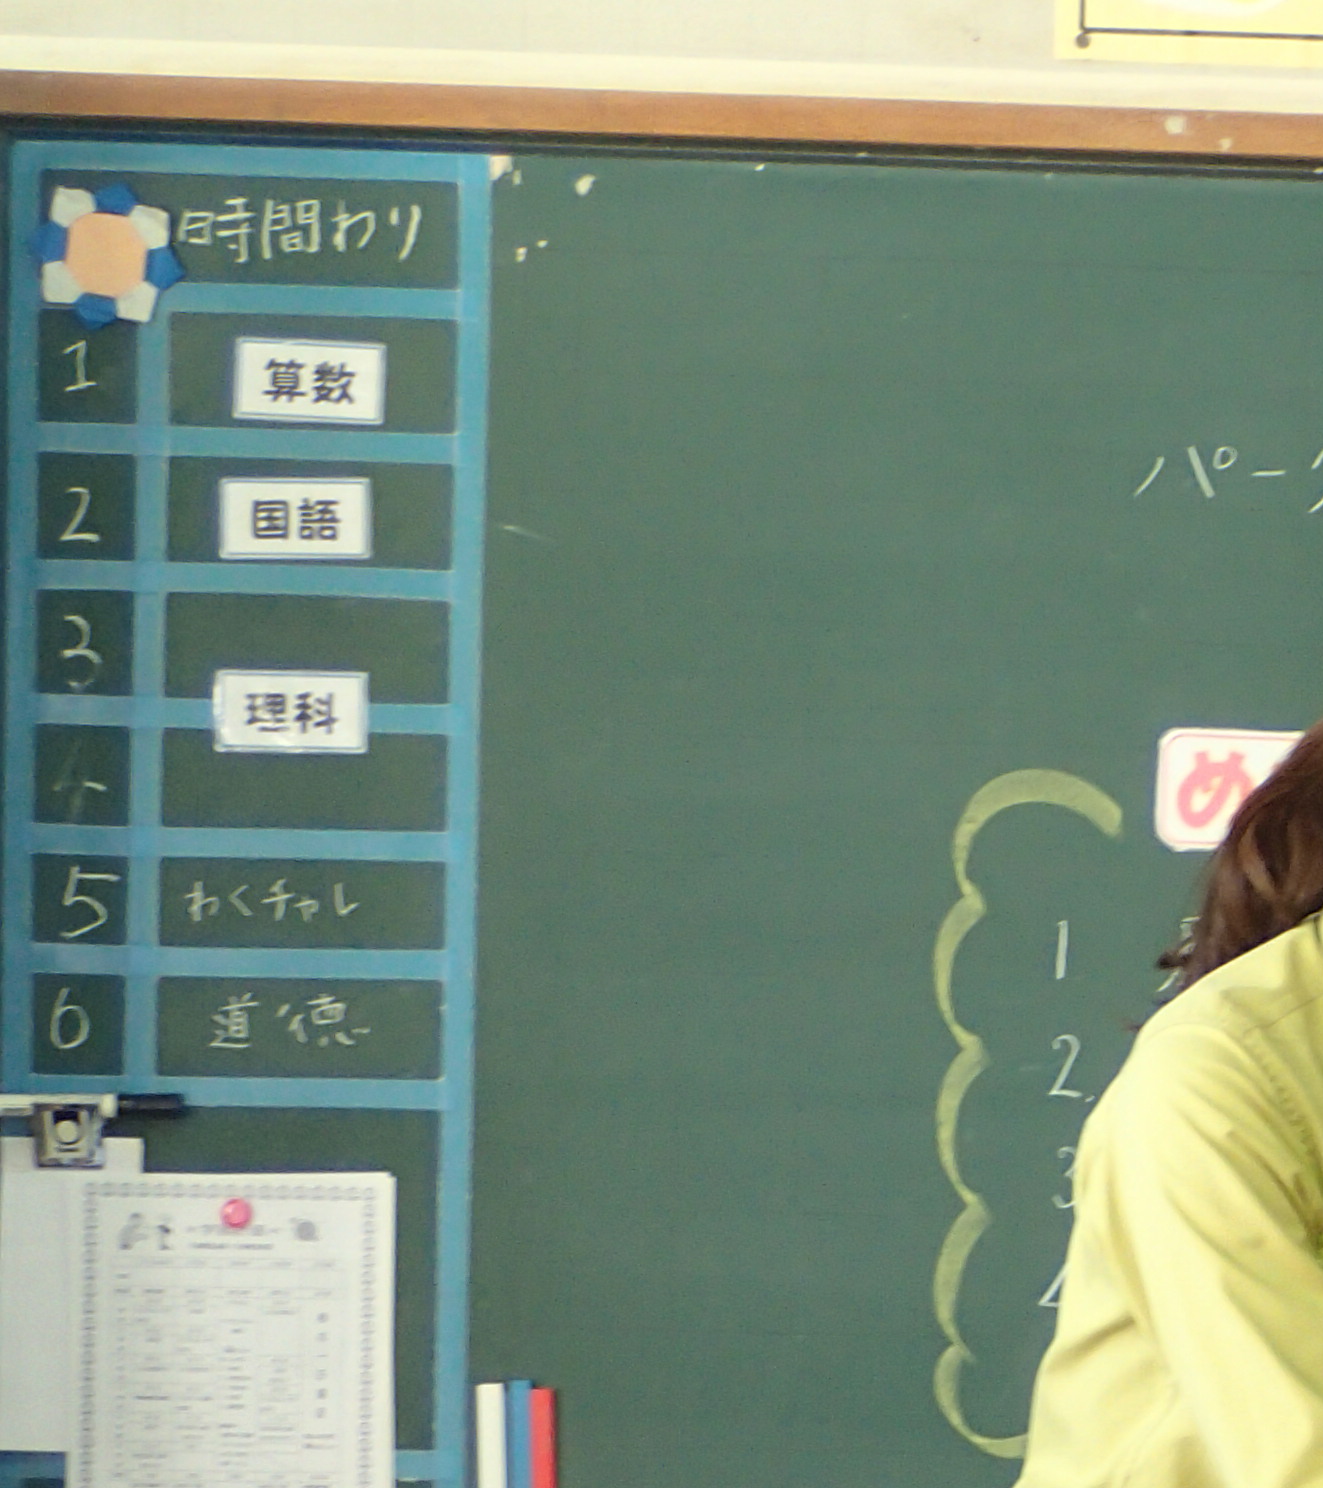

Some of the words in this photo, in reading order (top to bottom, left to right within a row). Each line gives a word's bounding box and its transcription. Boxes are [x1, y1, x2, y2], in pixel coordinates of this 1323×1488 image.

[177, 196, 422, 264] 時間わり
[62, 340, 97, 392] 1
[263, 357, 358, 405] 算数
[60, 487, 100, 542] 2
[251, 497, 341, 541] 国語
[244, 691, 340, 735] 理科
[61, 866, 121, 939] 5
[49, 986, 91, 1050] 6
